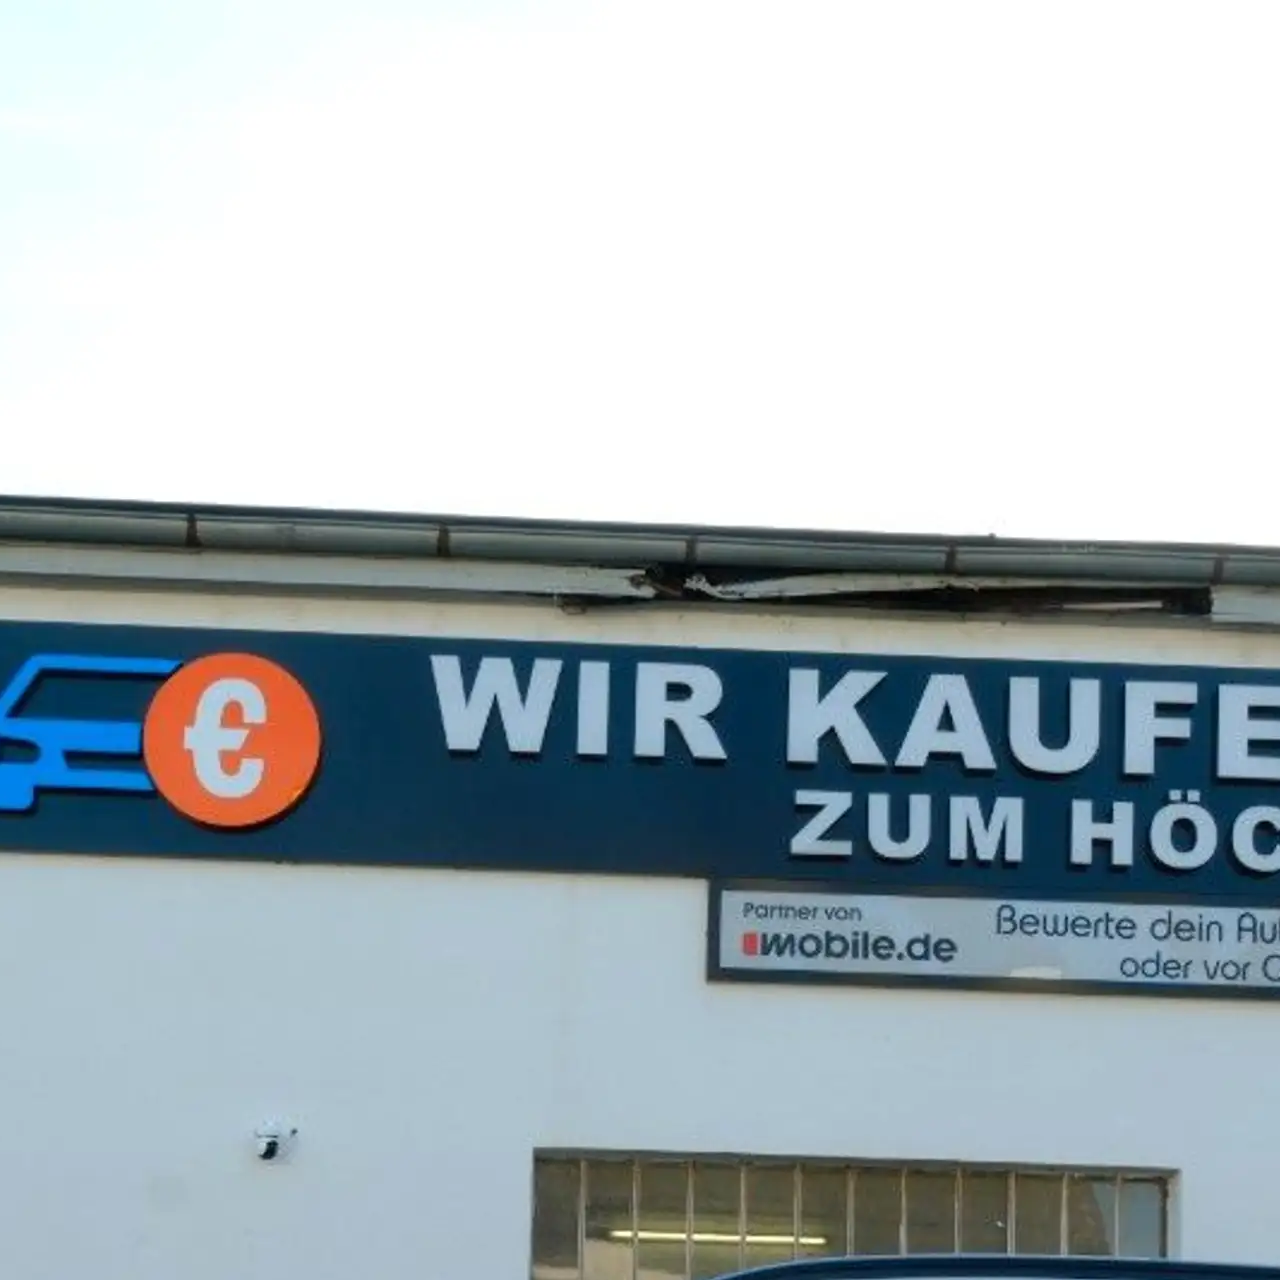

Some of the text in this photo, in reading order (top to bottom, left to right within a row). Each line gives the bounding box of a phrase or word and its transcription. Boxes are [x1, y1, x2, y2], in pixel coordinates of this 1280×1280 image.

[429, 654, 728, 761] WIR
[184, 677, 267, 798] €
[789, 789, 1024, 863] ZUM
[742, 901, 863, 922] Partner von
[996, 904, 1137, 940] Bewerte
[1149, 909, 1224, 943] dein
[759, 930, 959, 963] mobile.de
[1119, 949, 1193, 980] oder
[1202, 959, 1252, 982] vor
